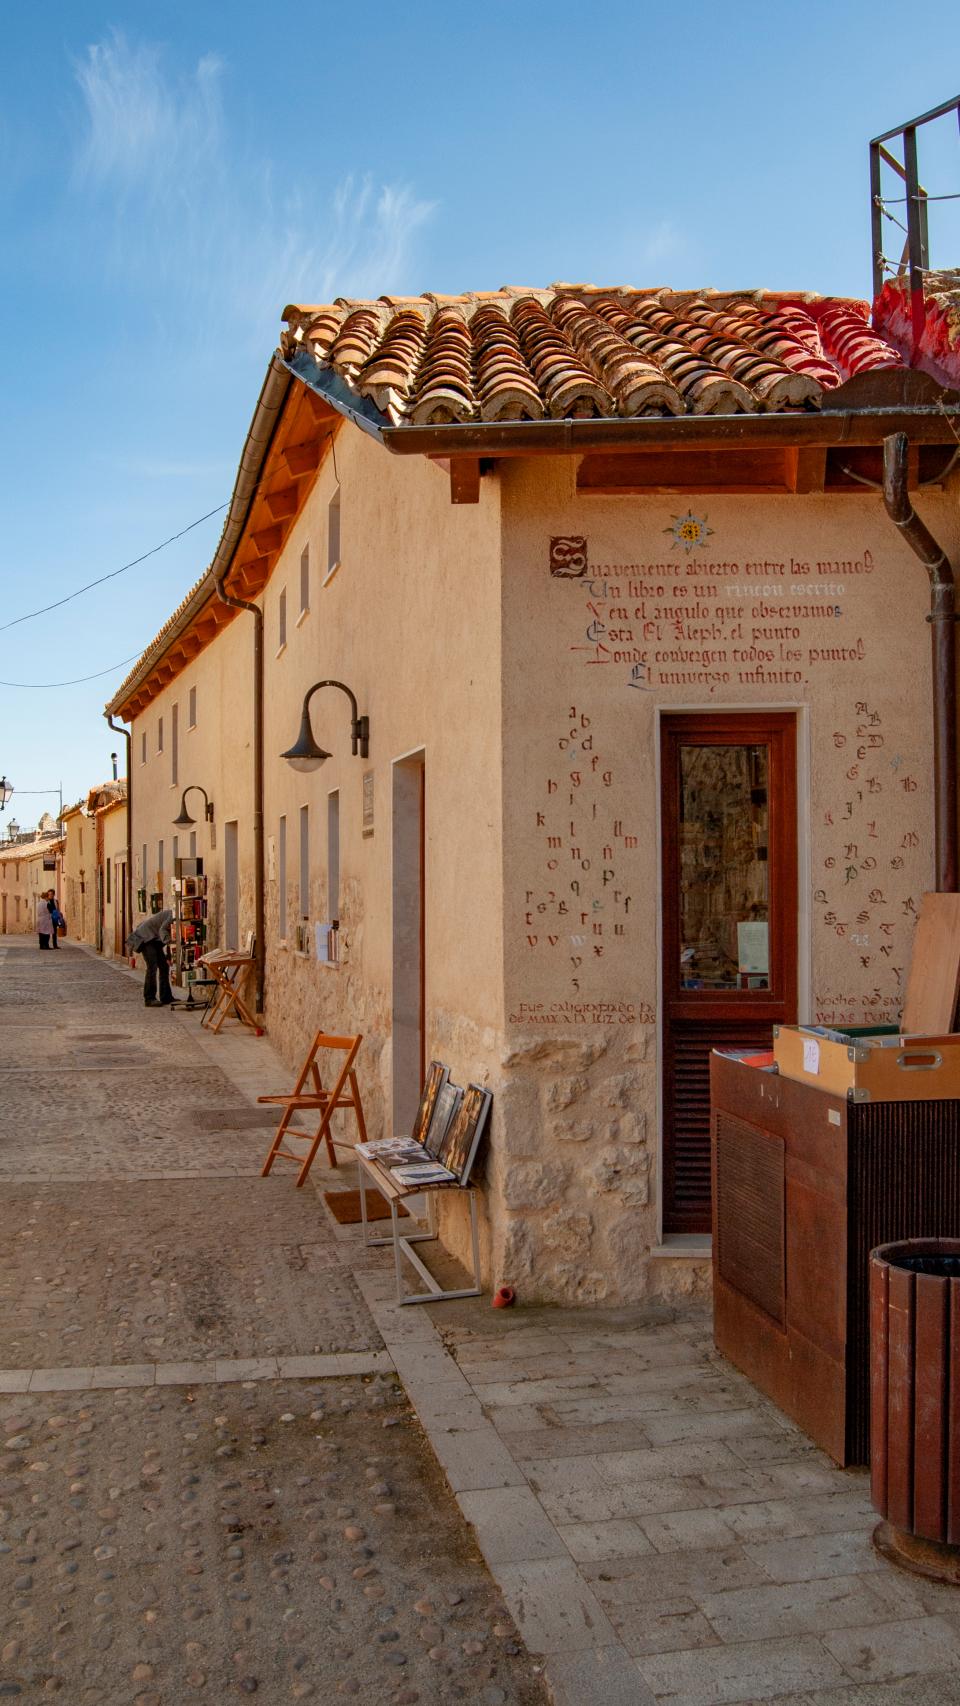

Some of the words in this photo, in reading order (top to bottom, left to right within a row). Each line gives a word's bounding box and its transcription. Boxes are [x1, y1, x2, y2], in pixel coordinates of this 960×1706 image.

[686, 559, 739, 577] abierto
[745, 559, 785, 576] entre
[790, 558, 810, 576] las
[628, 580, 665, 598] libro
[672, 584, 688, 598] es
[693, 584, 718, 598] un
[790, 581, 845, 597] escrito
[609, 606, 627, 620] en
[635, 602, 646, 620] el
[715, 606, 744, 624] que
[731, 624, 743, 640] el
[752, 625, 800, 646] punto
[655, 647, 727, 667] convergen
[732, 645, 776, 662] todos
[779, 643, 802, 661] los
[659, 672, 730, 692] universo
